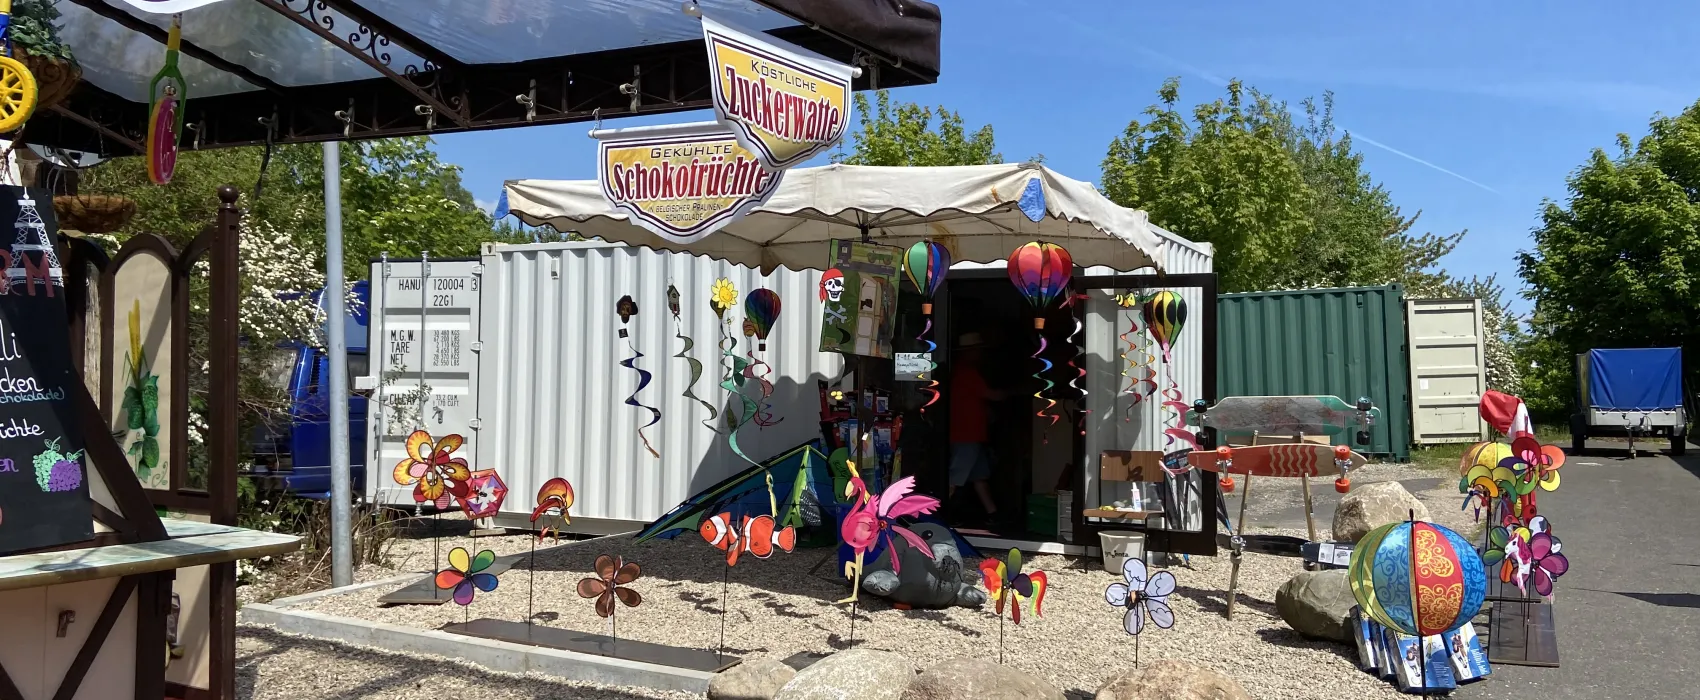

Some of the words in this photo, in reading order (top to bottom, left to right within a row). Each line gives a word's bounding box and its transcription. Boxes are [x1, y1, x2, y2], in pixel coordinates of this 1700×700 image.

[751, 60, 817, 93] KÖSTLICHE
[726, 66, 839, 142] Zuckerwatte
[651, 144, 733, 159] GEKÜHLTE
[613, 156, 770, 200] Schokofrüchte
[665, 213, 703, 222] SCHOKOLADE
[398, 279, 421, 291] HANU
[433, 279, 464, 291] 120004
[471, 278, 478, 291] 3
[433, 294, 454, 307] 22G1
[390, 329, 416, 342] M.G.W.
[390, 341, 410, 354] TARE
[390, 353, 404, 365] NET
